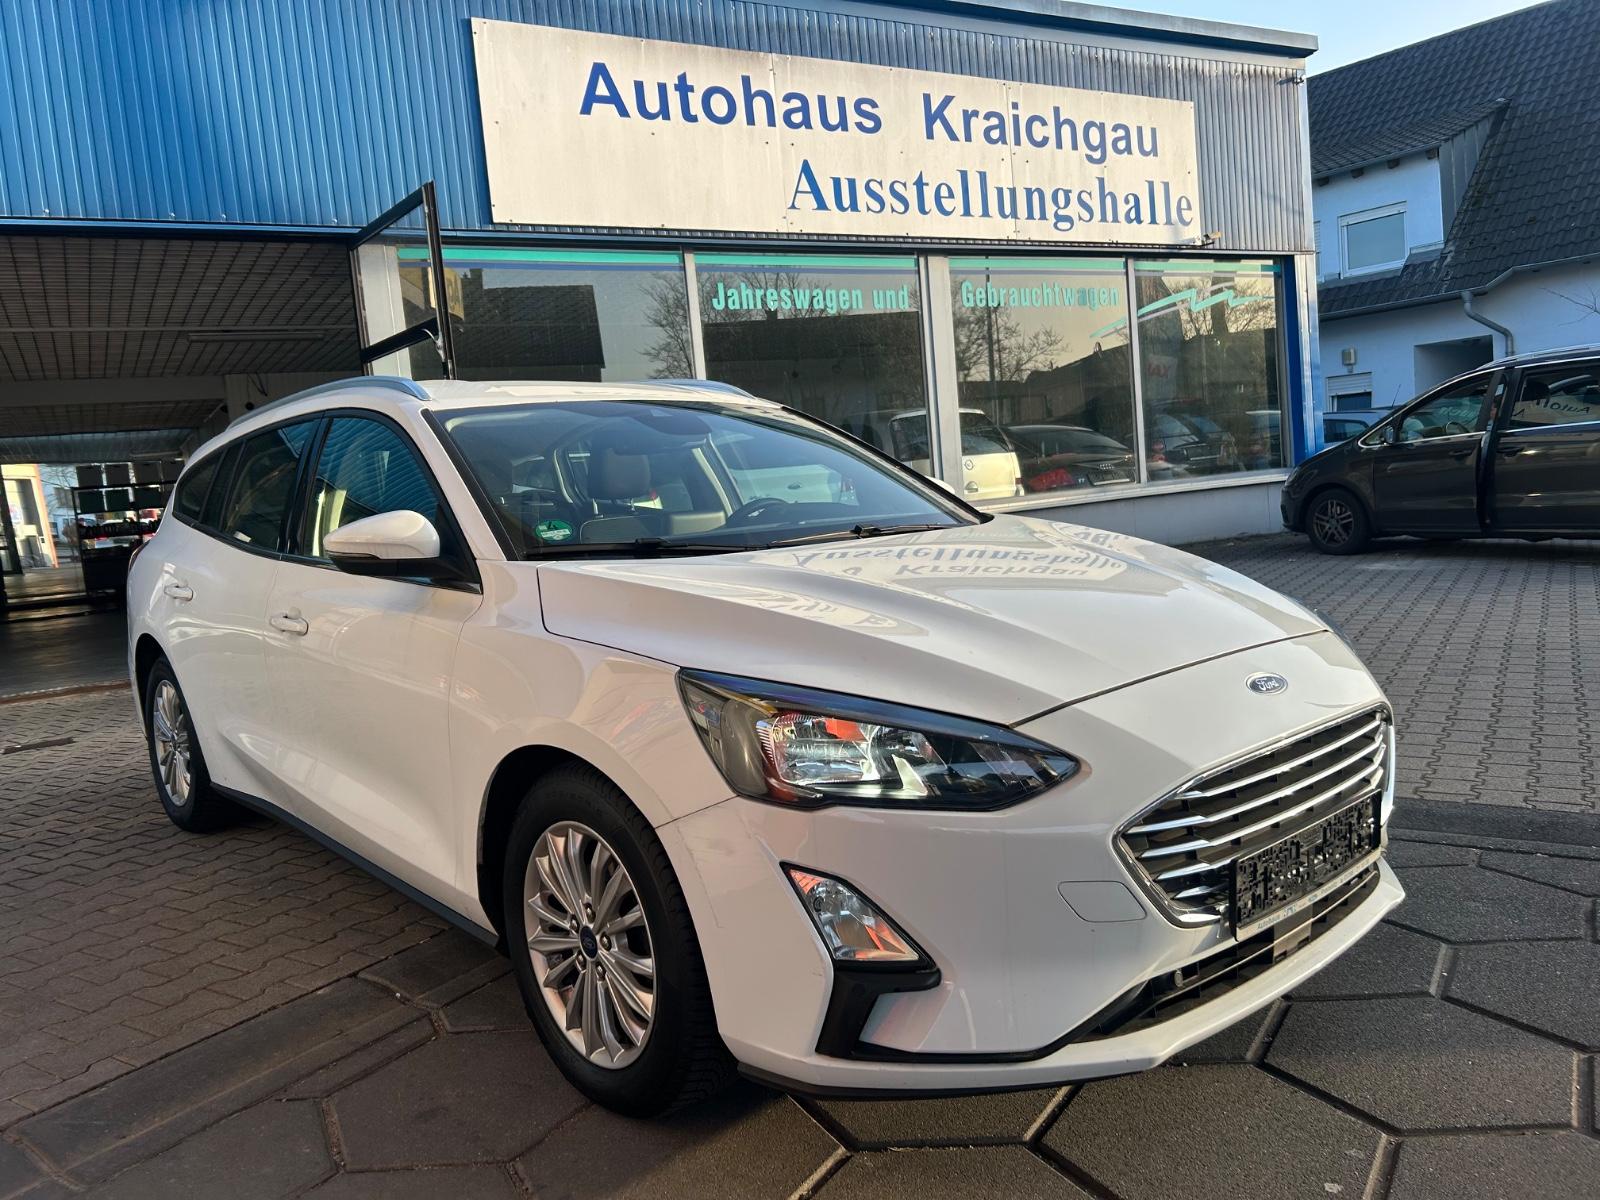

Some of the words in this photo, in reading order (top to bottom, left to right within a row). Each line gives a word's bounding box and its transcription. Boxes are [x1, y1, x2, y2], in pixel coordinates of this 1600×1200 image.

[579, 62, 882, 134] Autohaus
[922, 92, 1159, 164] Kraichgau
[788, 159, 1193, 232] Ausstellungshalle
[712, 282, 863, 314] Jahreswagen
[872, 285, 909, 310] und
[961, 280, 1119, 311] Gebrauchtwagen
